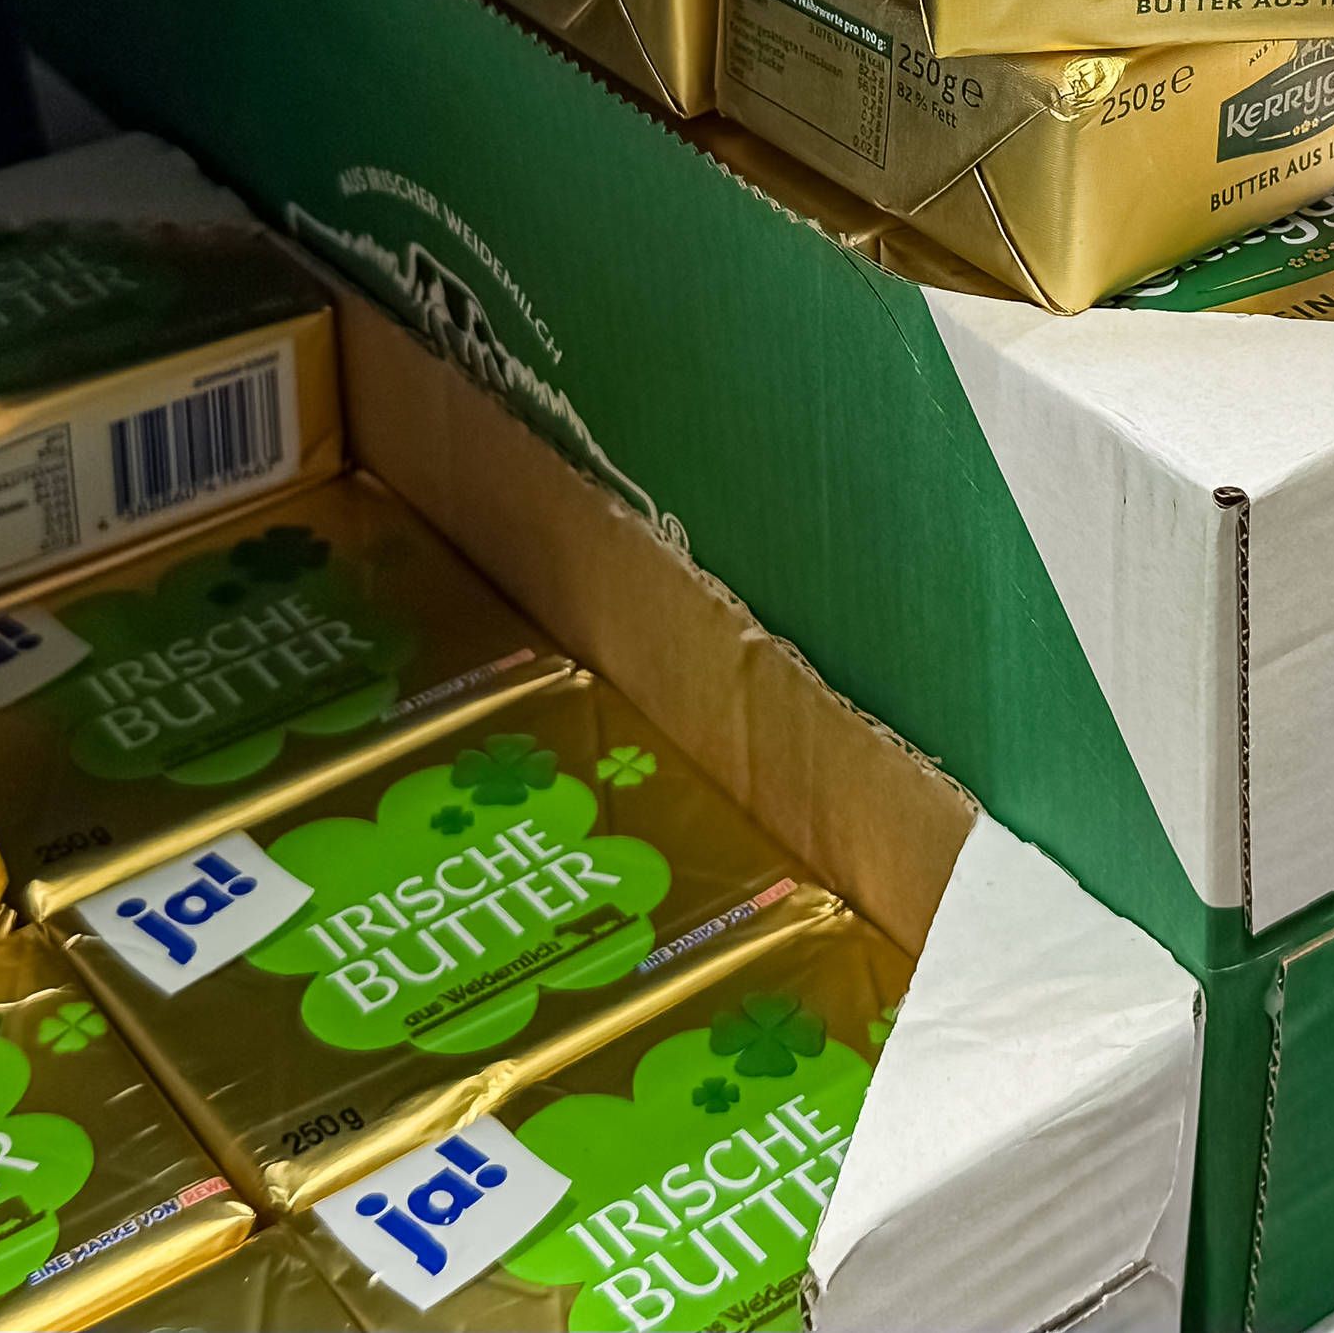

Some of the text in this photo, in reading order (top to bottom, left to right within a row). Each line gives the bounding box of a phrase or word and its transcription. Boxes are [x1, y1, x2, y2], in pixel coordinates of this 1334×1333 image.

[897, 82, 912, 103] 82
[931, 103, 958, 129] Fett
[1210, 167, 1280, 213] BUTTER
[1286, 147, 1322, 179] AUS
[443, 203, 563, 365] WEIDEMILCH
[83, 594, 326, 707] IRISCHE
[102, 619, 375, 751] BUTTER
[117, 851, 258, 966] ja!
[306, 818, 563, 961] IRISCHE
[325, 850, 622, 1015] BUTTER
[404, 940, 563, 1028] aus Weidemilch
[28, 1251, 74, 1286] EINE
[70, 1219, 140, 1264] MARKE
[140, 1198, 182, 1227] VON
[355, 1134, 508, 1276] ja!
[567, 1093, 842, 1268] IRISCHE
[594, 1136, 852, 1332] BUTTE
